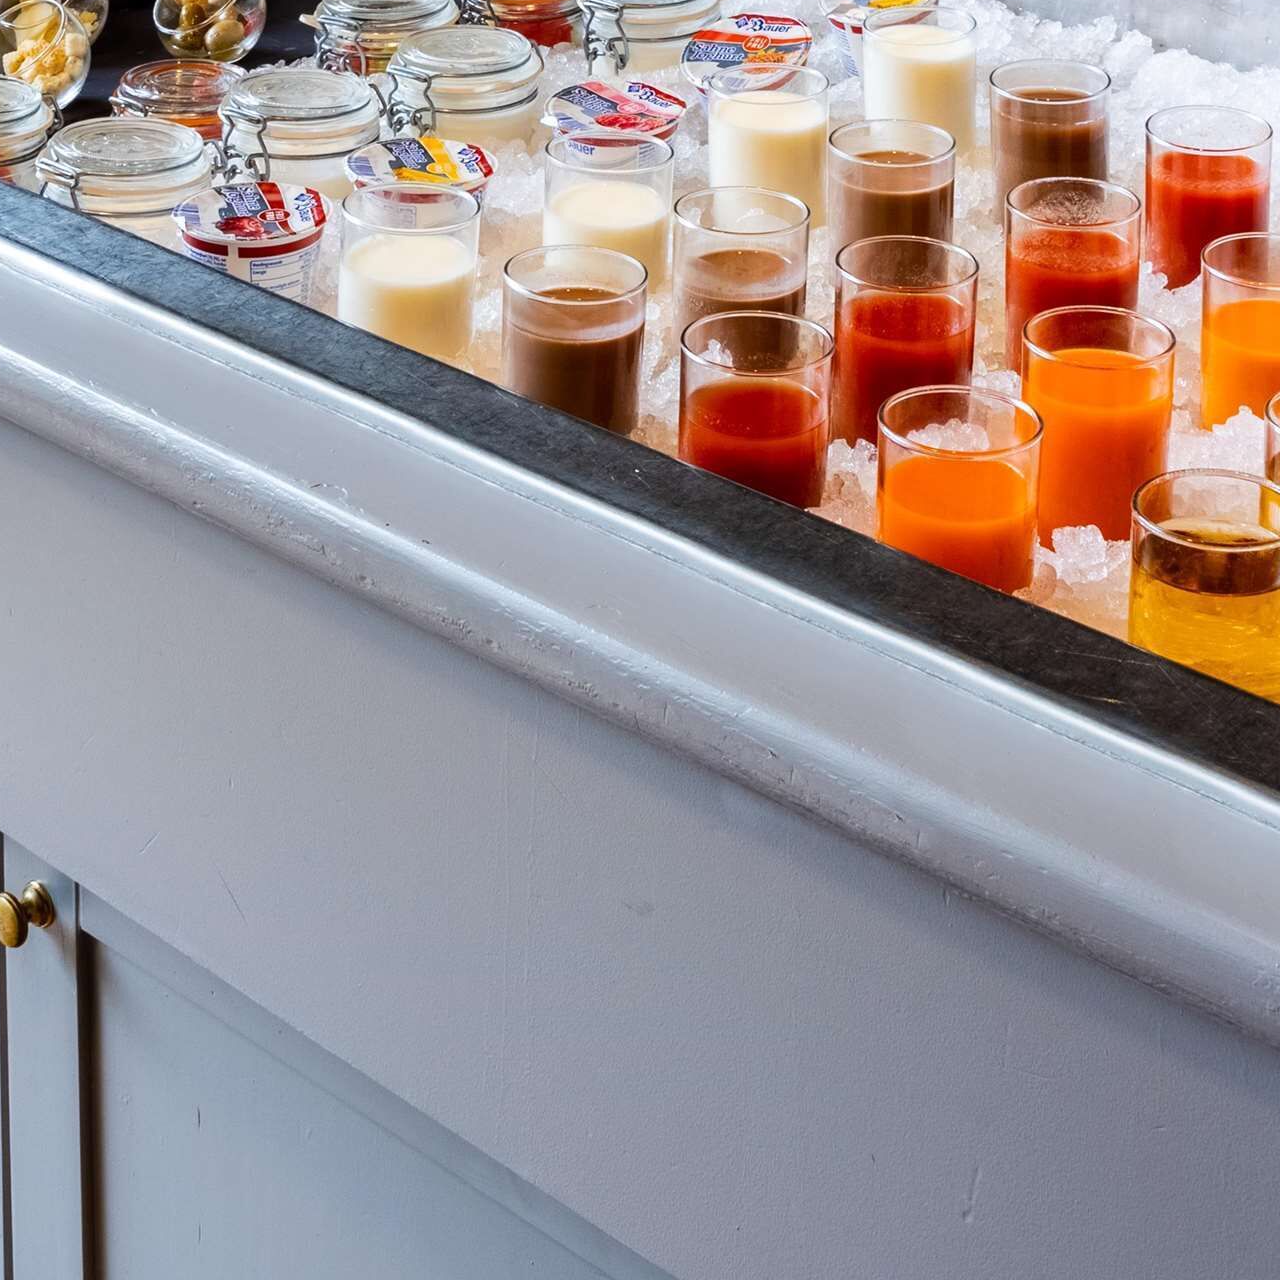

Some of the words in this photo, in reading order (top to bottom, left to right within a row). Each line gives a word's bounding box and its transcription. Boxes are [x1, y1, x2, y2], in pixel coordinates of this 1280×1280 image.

[746, 19, 793, 33] Bauer
[692, 41, 737, 53] Sahne
[639, 88, 673, 109] Bauer
